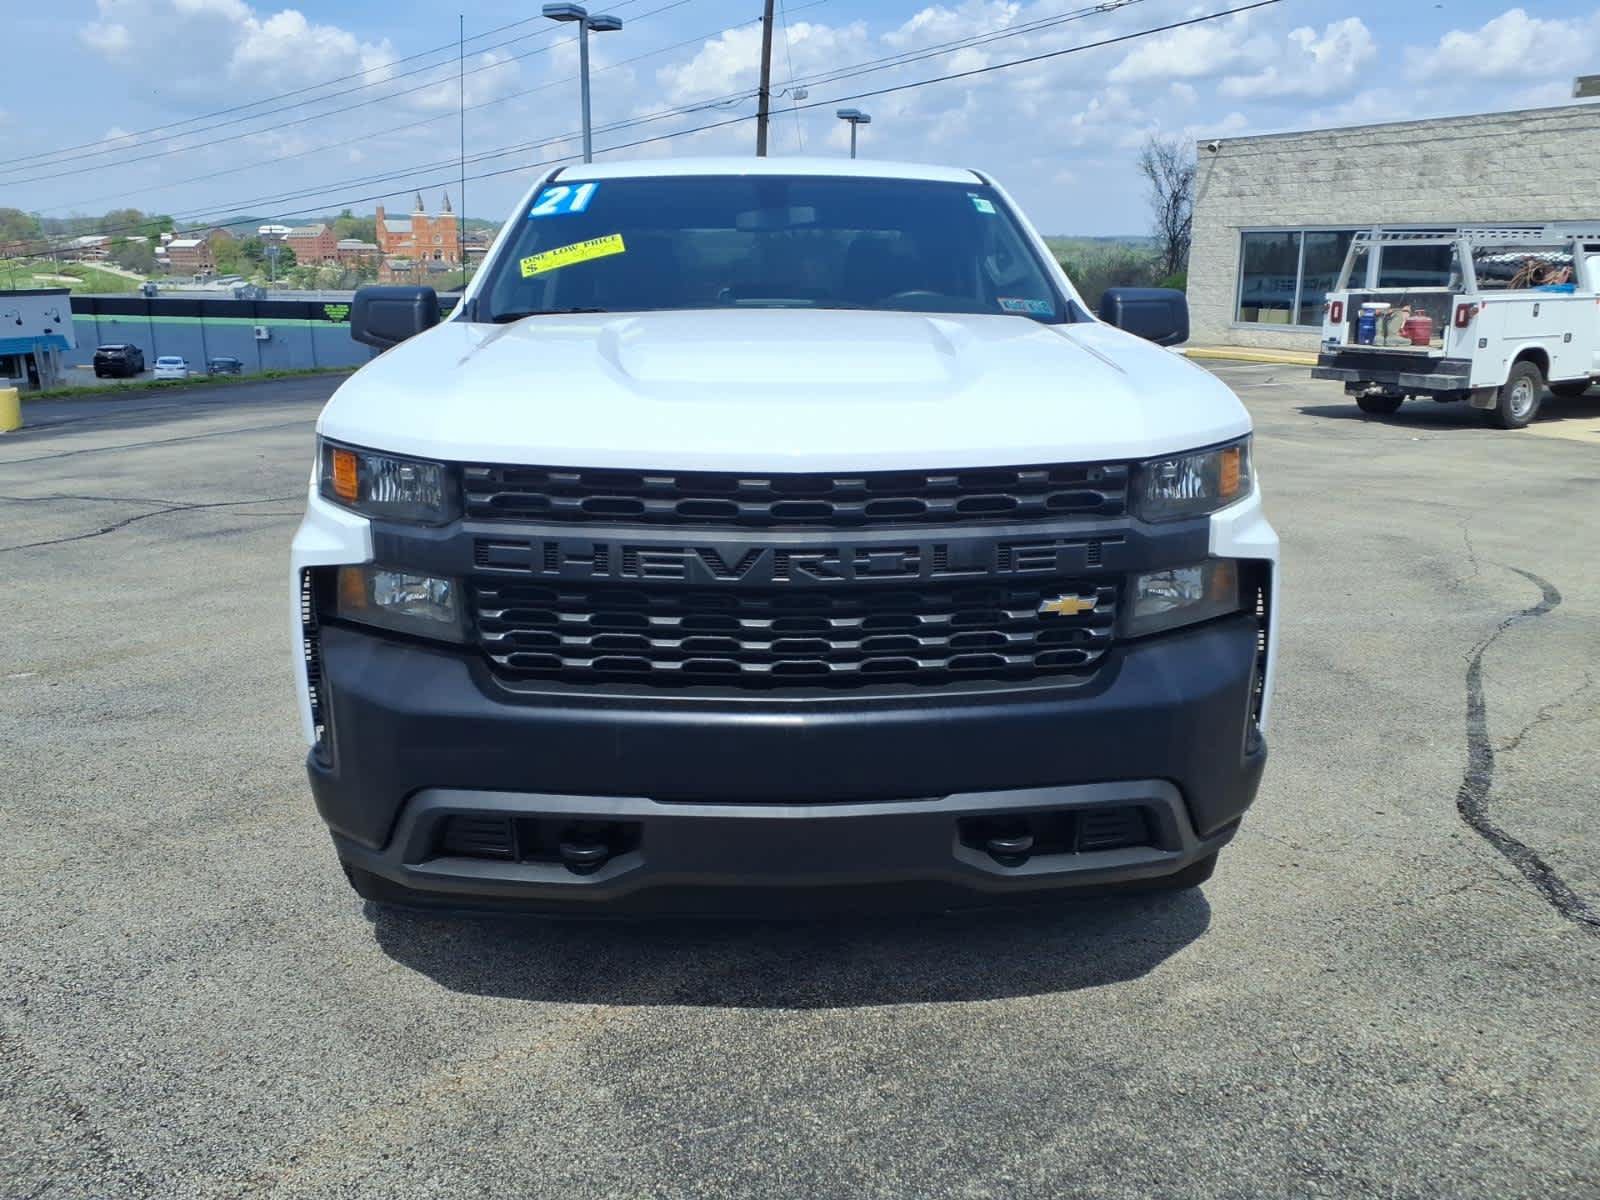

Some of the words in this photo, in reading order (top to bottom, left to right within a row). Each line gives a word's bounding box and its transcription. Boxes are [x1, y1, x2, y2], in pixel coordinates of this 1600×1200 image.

[531, 183, 594, 216] 21
[523, 254, 546, 264] ONE
[552, 245, 578, 255] LOW
[583, 236, 618, 248] PRICE
[473, 535, 1126, 582] CHEVROLET
